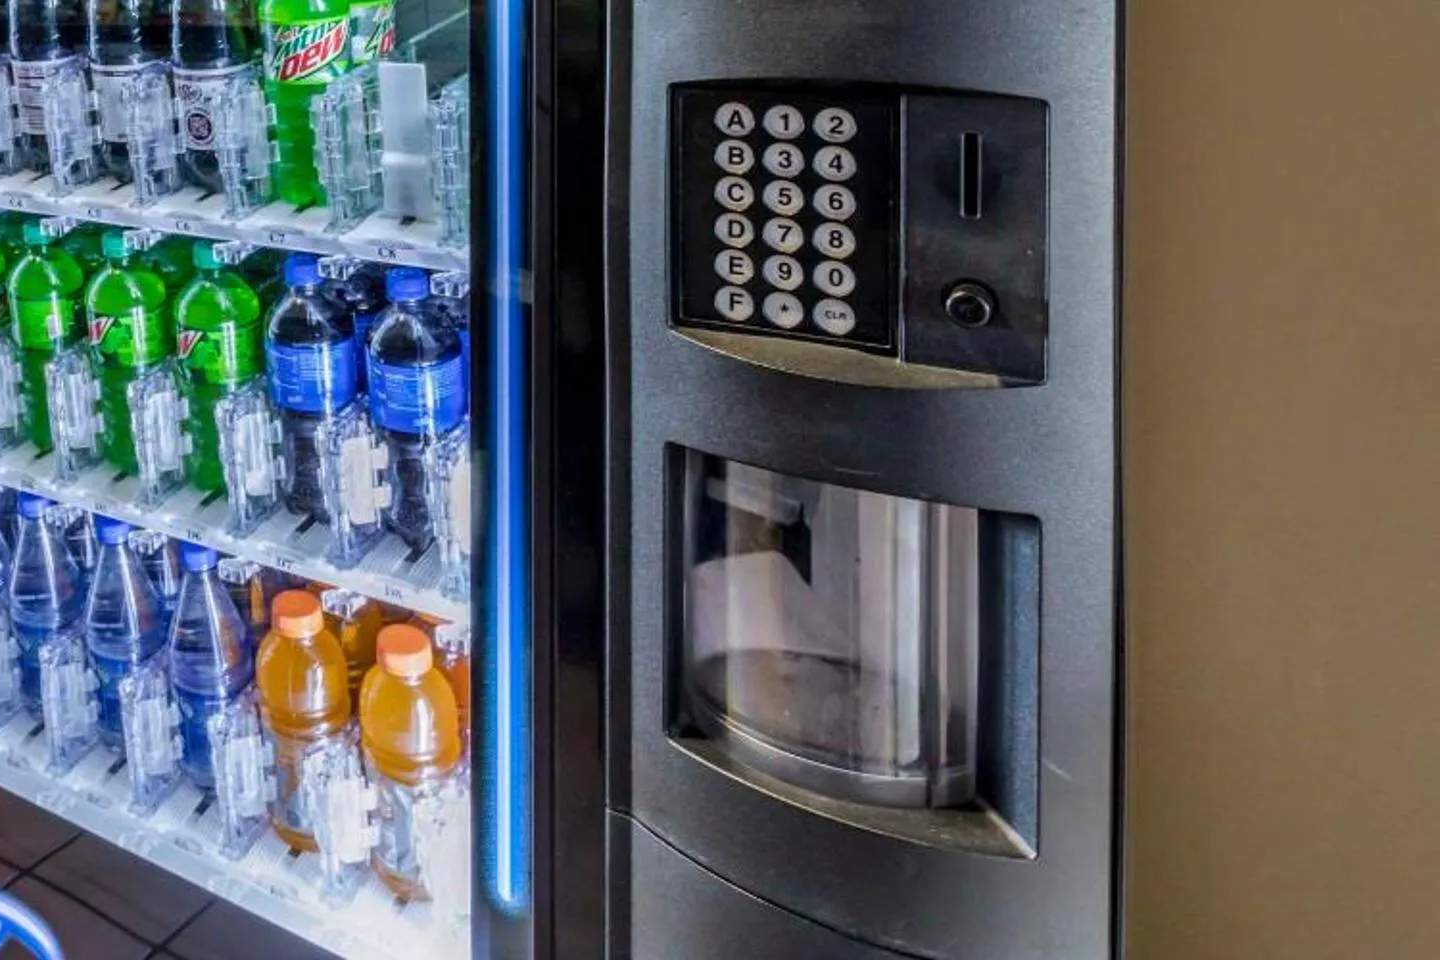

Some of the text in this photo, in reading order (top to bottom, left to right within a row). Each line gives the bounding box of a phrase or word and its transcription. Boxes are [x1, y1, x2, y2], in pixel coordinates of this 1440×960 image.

[727, 109, 746, 130] A
[779, 113, 790, 131] 1
[828, 116, 844, 135] 2
[728, 146, 745, 166] B
[778, 150, 792, 169] 3
[828, 154, 844, 173] 4
[727, 183, 745, 202] C
[778, 187, 792, 206] 5
[828, 192, 844, 210] 6
[270, 232, 286, 244] C7
[728, 219, 745, 238] D
[777, 224, 793, 243] 7
[828, 230, 843, 248] 8
[728, 256, 745, 275] E
[778, 262, 792, 281] 9
[828, 268, 843, 287] 0
[729, 293, 744, 312] F
[824, 310, 848, 320] CLR
